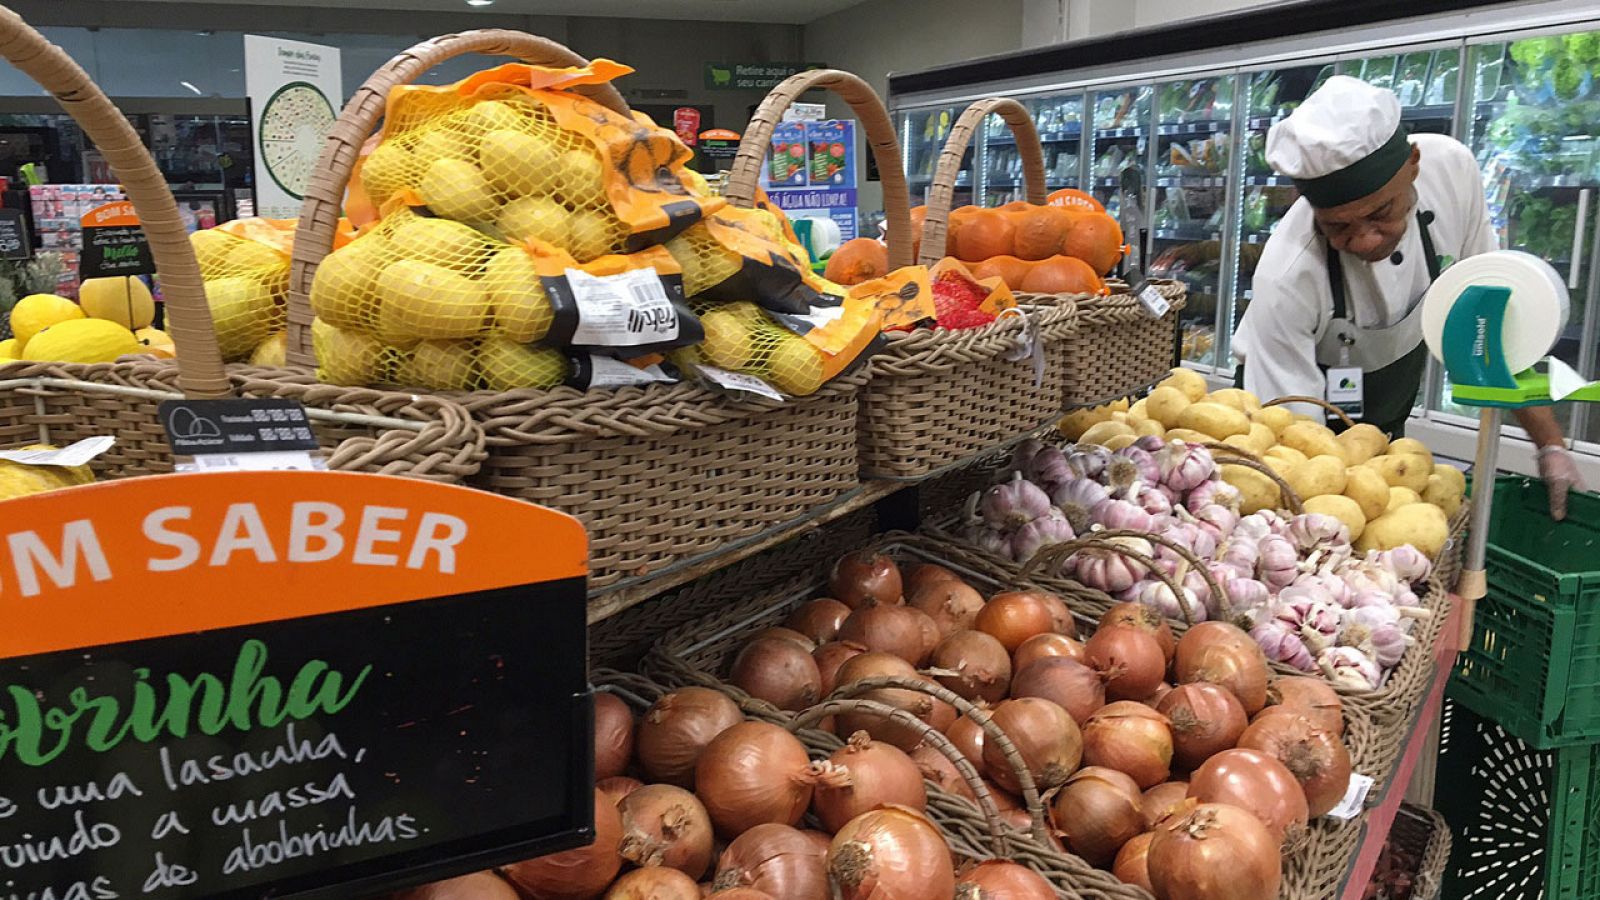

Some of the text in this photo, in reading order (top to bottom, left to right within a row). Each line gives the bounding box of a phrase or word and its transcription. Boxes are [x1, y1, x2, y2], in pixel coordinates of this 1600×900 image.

[736, 65, 796, 78] Retire aqui o
[737, 79, 754, 87] seu
[781, 192, 802, 209] ÁGUA
[804, 191, 820, 207] NÃO
[141, 502, 468, 575] SABER
[151, 811, 191, 841] a
[212, 772, 356, 827] massa
[142, 851, 197, 894] de
[222, 805, 431, 875] abobrinhas.
